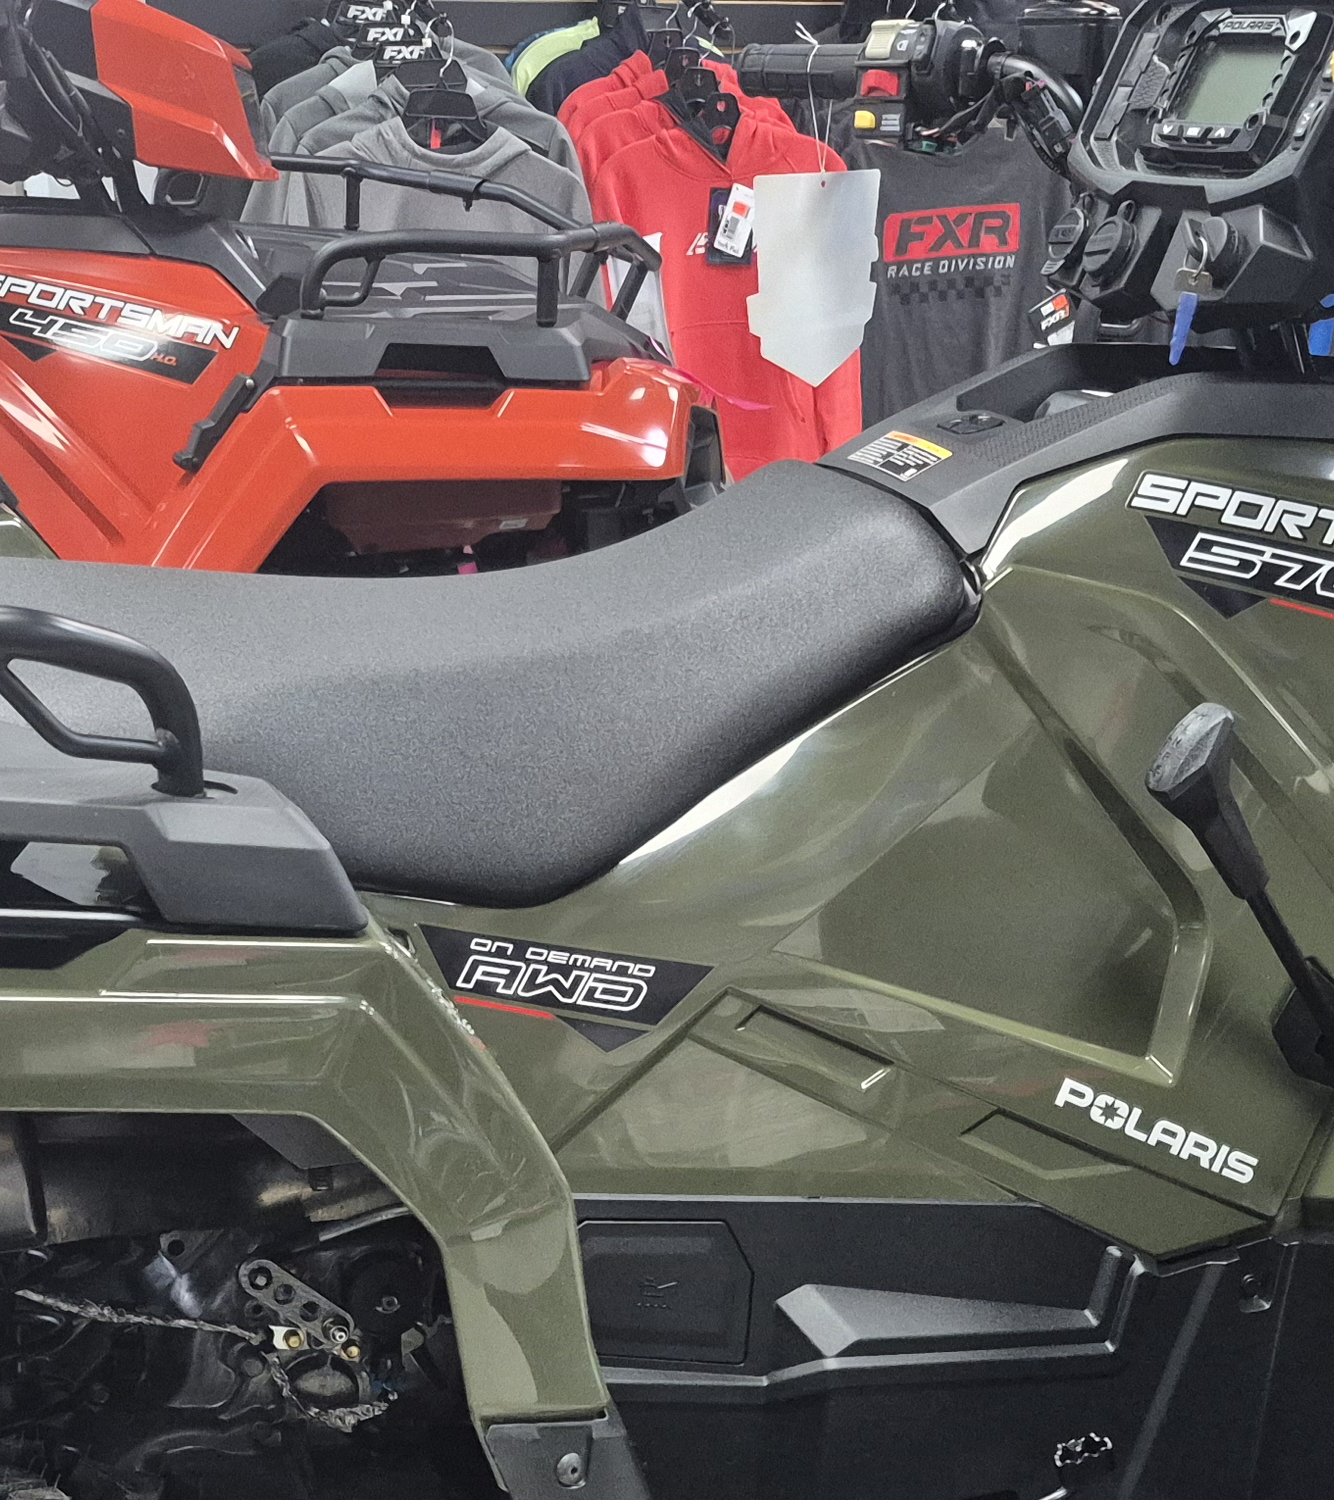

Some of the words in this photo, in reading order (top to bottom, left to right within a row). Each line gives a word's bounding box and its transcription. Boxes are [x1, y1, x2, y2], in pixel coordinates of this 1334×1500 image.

[1222, 19, 1276, 31] POLARIS
[894, 209, 1012, 257] FXR
[887, 261, 934, 279] RACE
[938, 253, 1016, 273] DIVISION
[9, 308, 158, 362] 450
[470, 938, 515, 955] ON
[525, 946, 656, 978] DEMAND
[455, 955, 648, 1011] AWD
[1054, 1077, 1260, 1184] POLARIS
